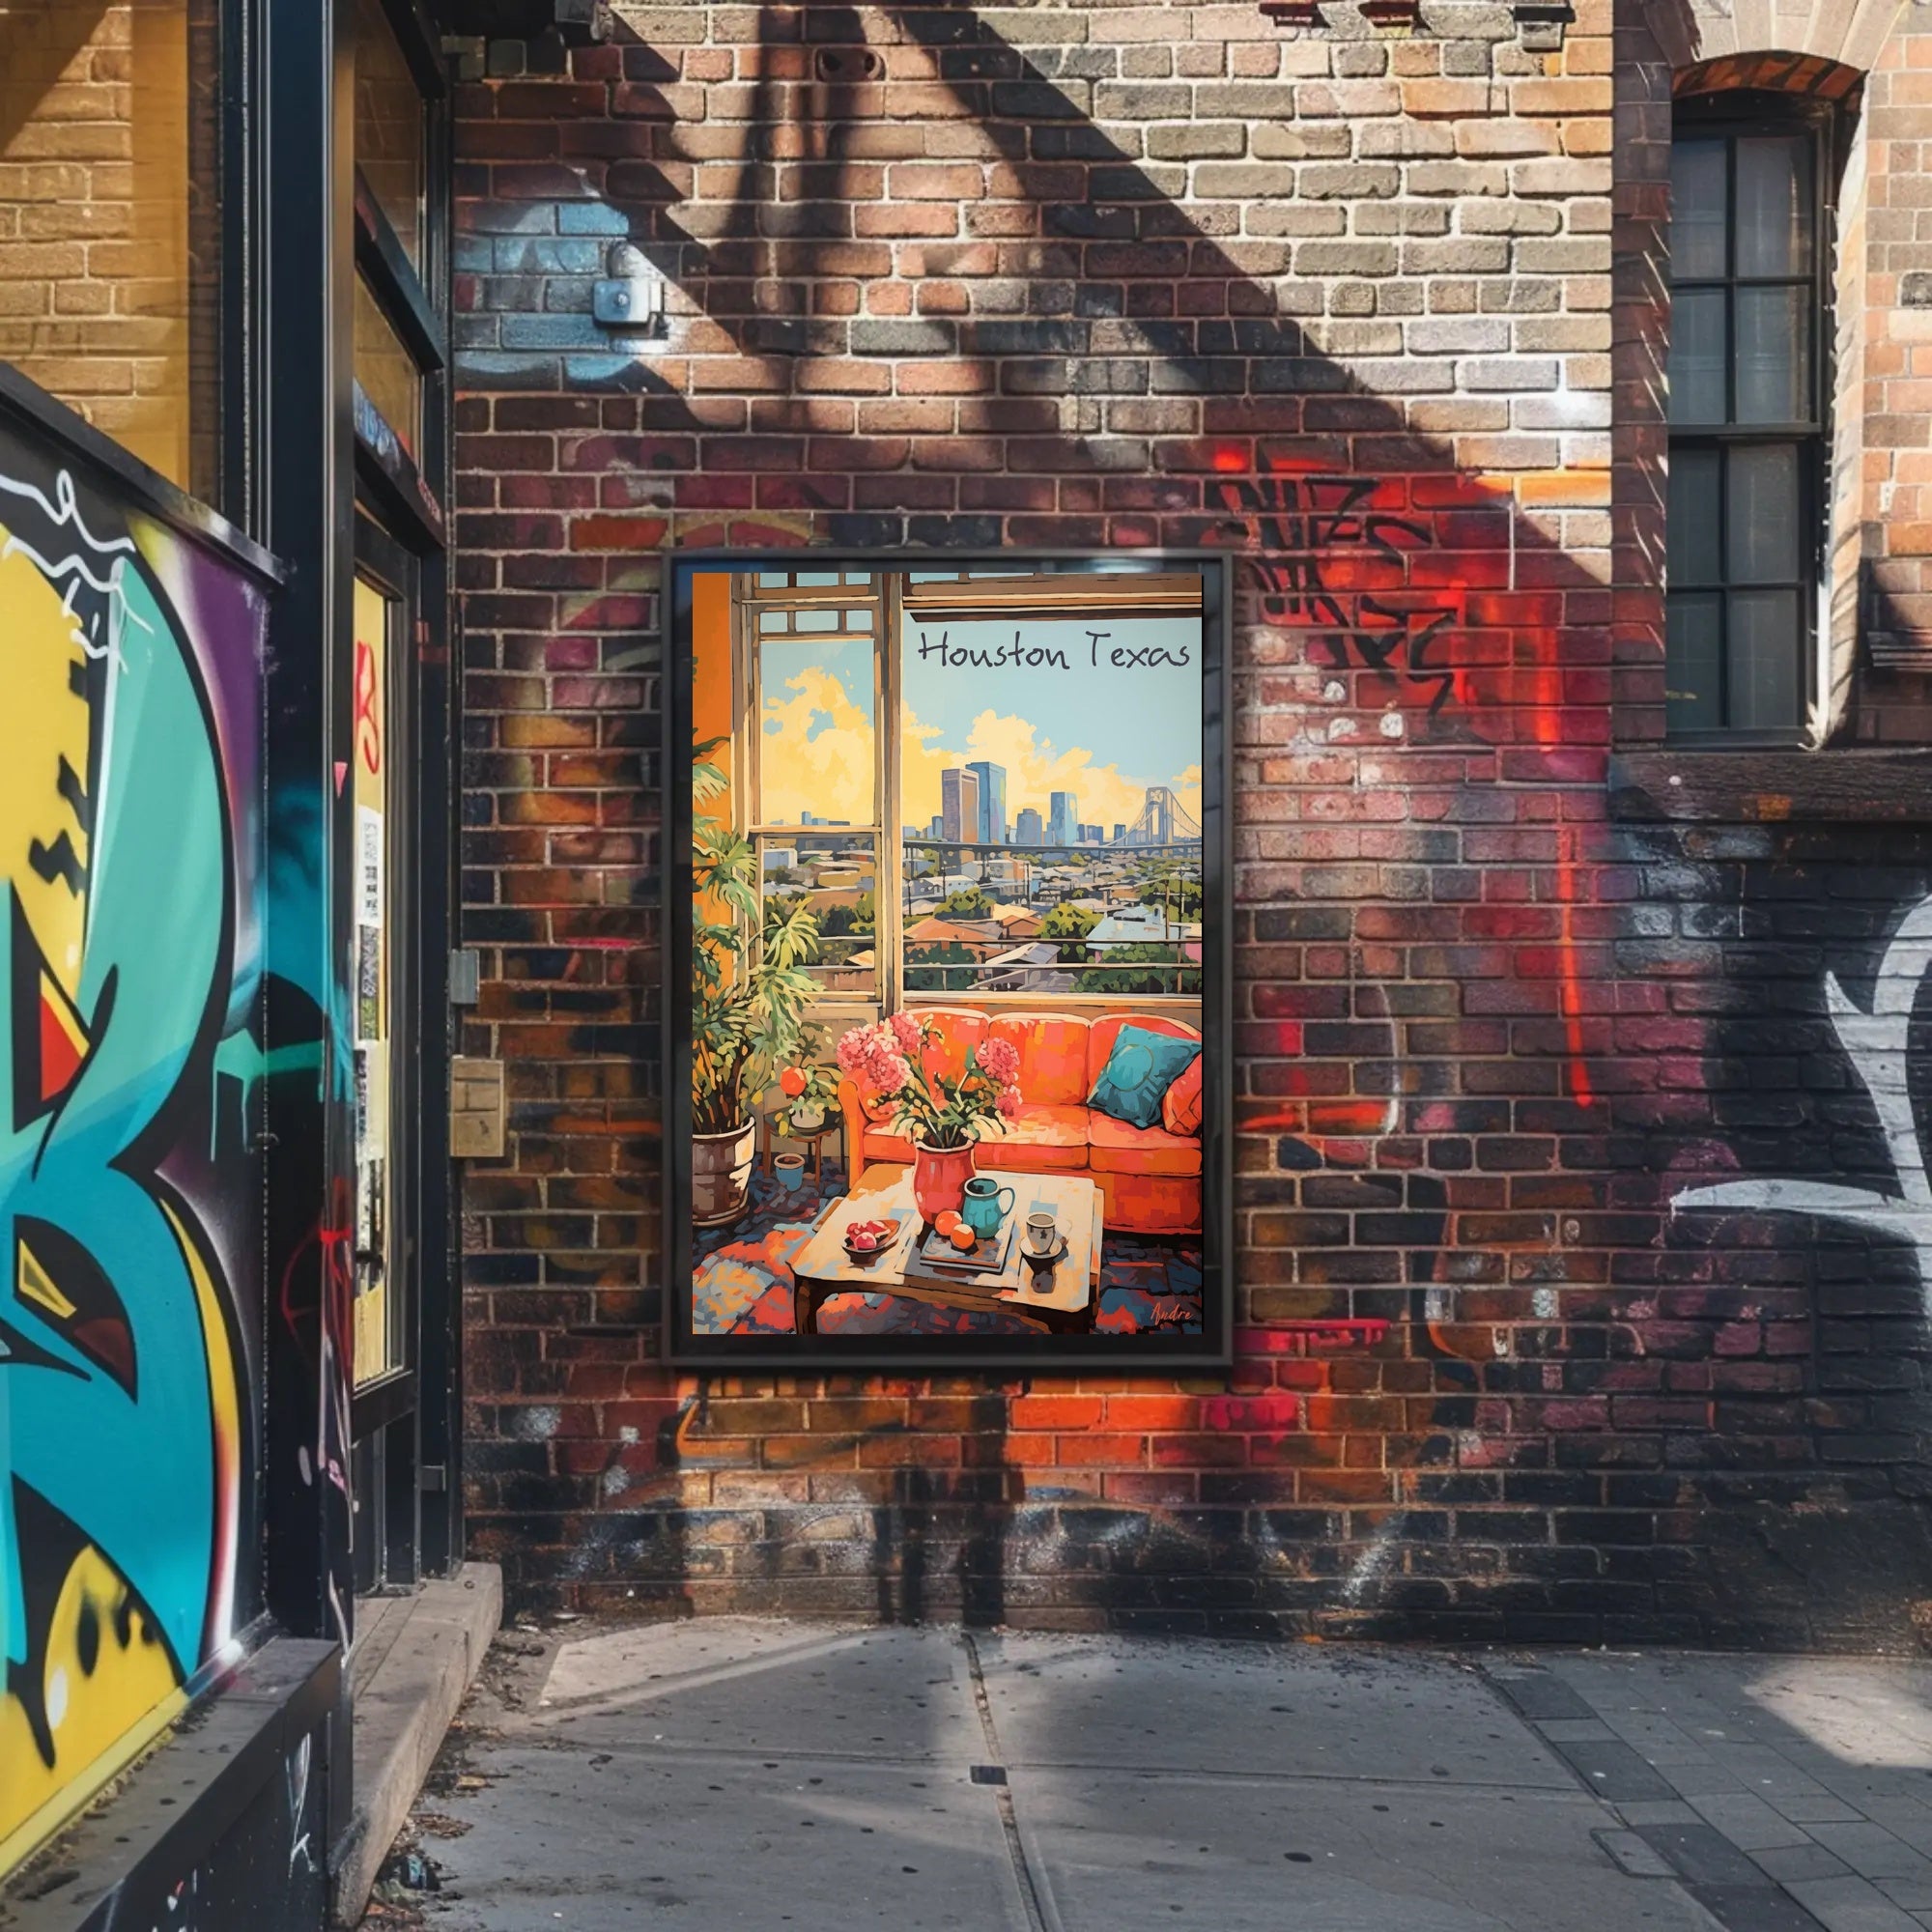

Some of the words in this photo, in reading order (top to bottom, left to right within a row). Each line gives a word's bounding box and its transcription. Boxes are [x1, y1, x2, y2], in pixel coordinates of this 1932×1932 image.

[918, 631, 1070, 669] Houston
[1085, 631, 1190, 668] Texas
[1151, 1301, 1192, 1325] Andre
